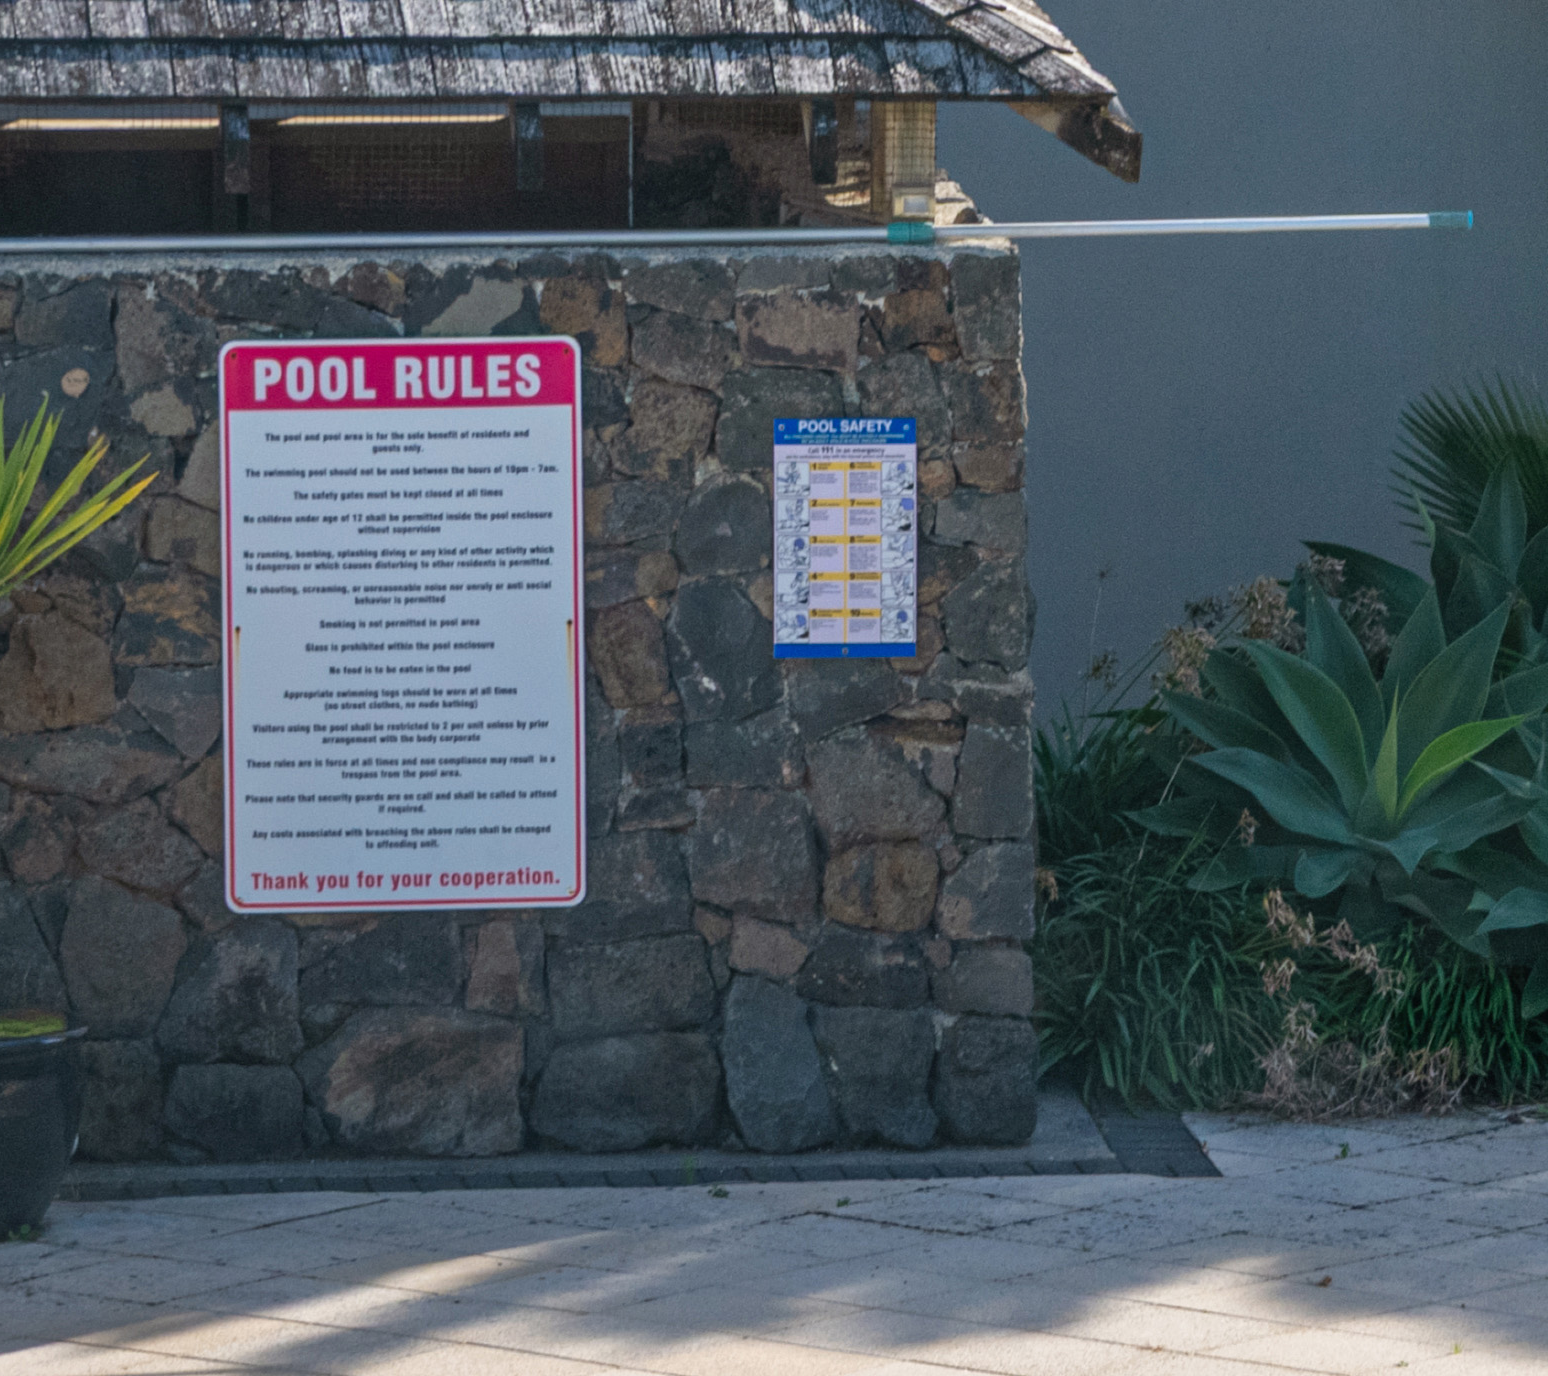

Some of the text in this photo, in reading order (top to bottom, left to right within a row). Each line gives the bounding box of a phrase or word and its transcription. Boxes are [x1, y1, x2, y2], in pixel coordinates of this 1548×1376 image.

[254, 354, 540, 401] POOL RULES
[798, 419, 892, 433] POOL SAFETY
[251, 867, 560, 891] Thank you for your cooperation.
